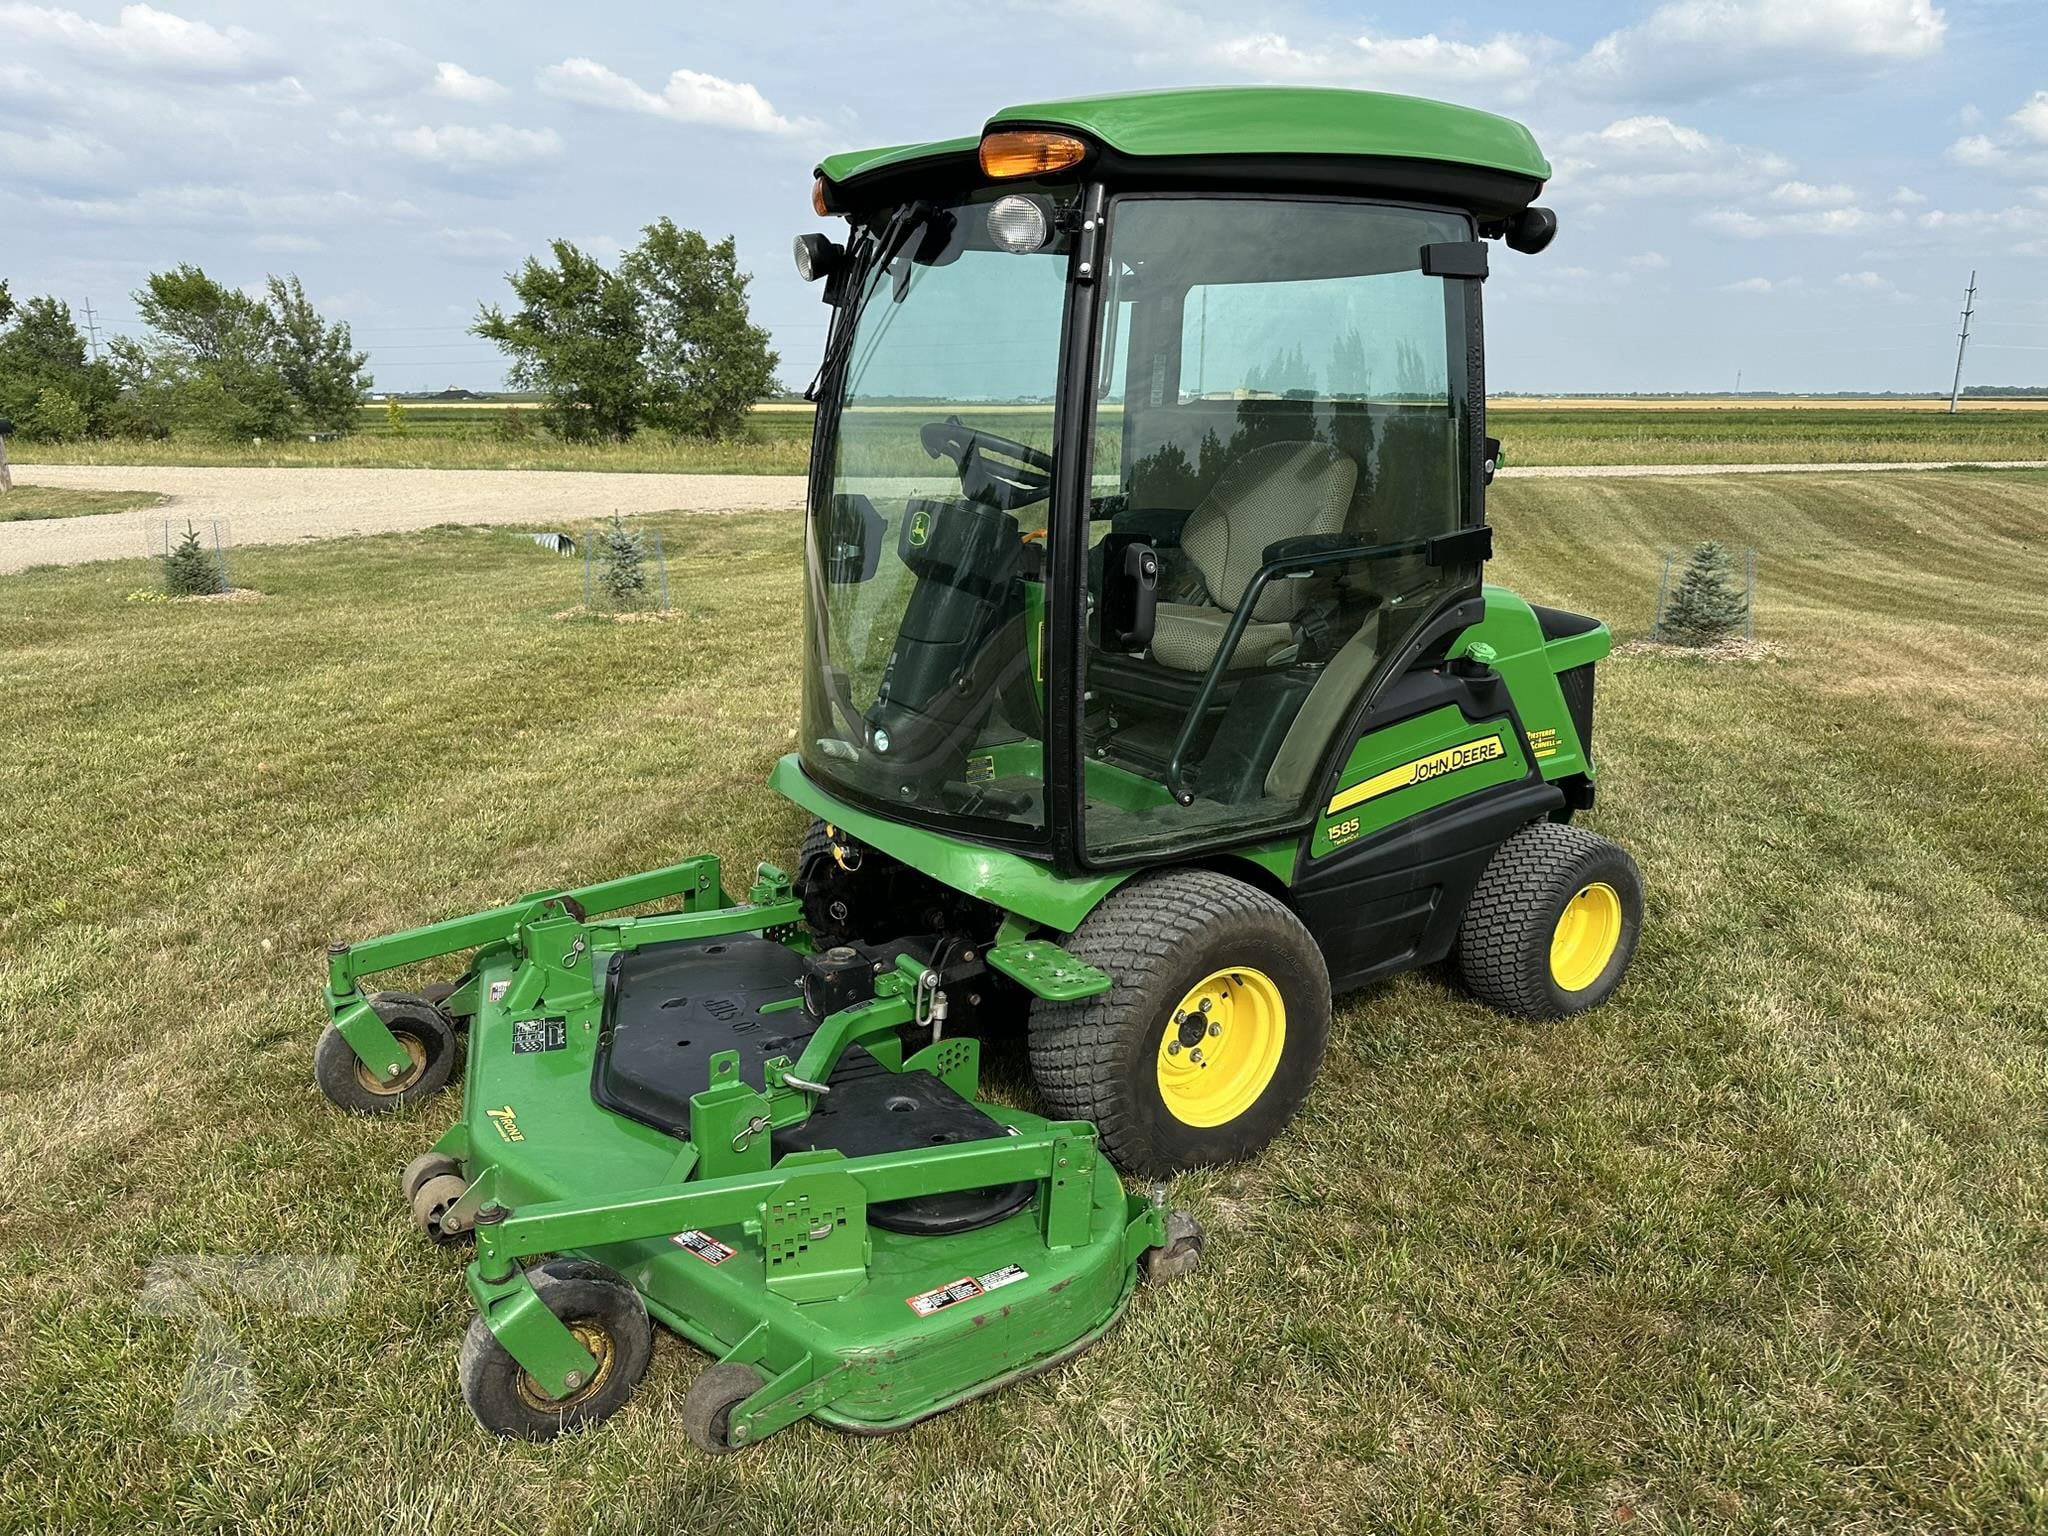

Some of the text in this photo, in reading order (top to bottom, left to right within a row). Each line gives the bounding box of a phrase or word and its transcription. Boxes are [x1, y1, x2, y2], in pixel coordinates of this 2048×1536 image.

[1409, 743, 1497, 783] JOHN DEERE
[1327, 817, 1360, 841] 1585
